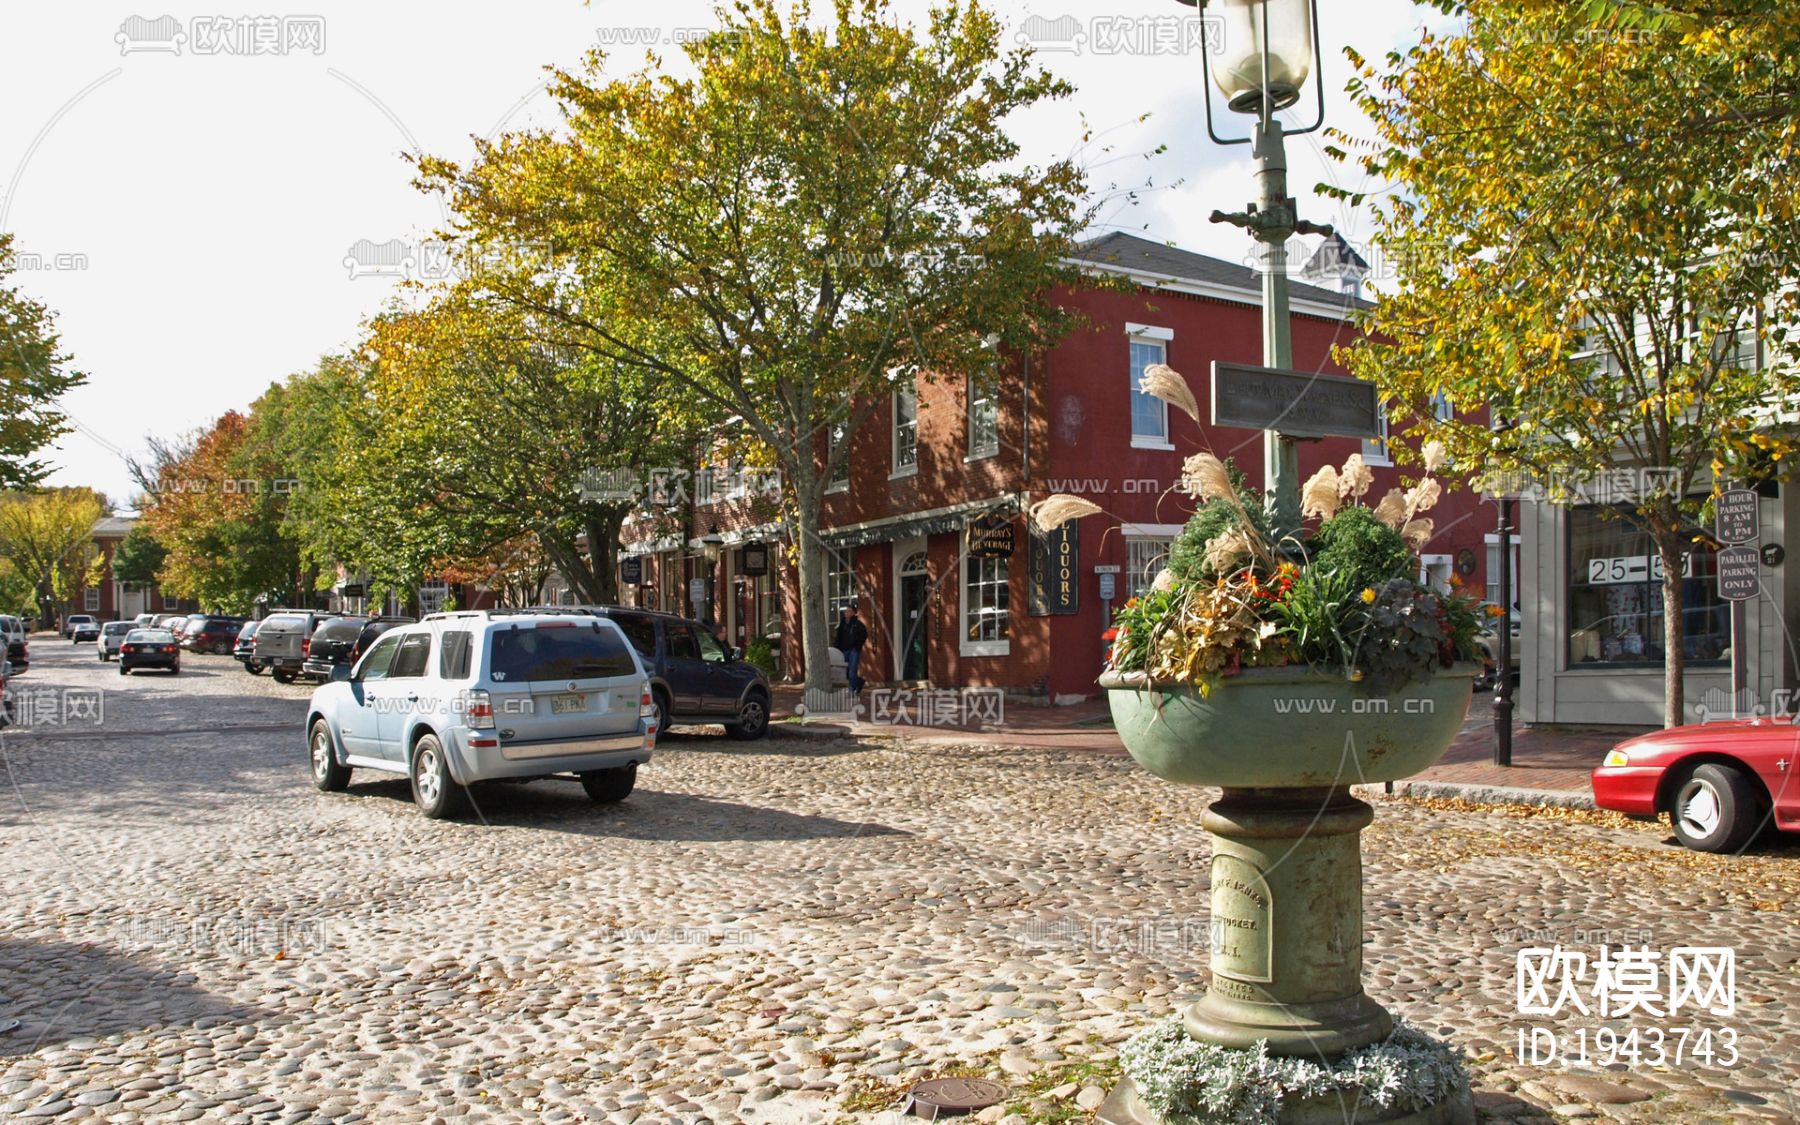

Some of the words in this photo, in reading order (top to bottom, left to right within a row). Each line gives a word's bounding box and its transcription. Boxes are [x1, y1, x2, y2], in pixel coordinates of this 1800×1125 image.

[1721, 496, 1725, 504] 1
[1729, 493, 1753, 504] HOUR
[1720, 504, 1754, 514] PARKING
[1723, 514, 1729, 522] 8
[1733, 513, 1751, 522] AM
[973, 527, 1011, 537] MURRAY'S
[1735, 527, 1751, 536] PM
[972, 540, 1011, 551] BEVERAGE
[1060, 520, 1070, 606] LIQUORS
[1721, 553, 1757, 564] PARALLEL
[1722, 567, 1757, 577] PARKING
[1724, 580, 1754, 589] ONLY
